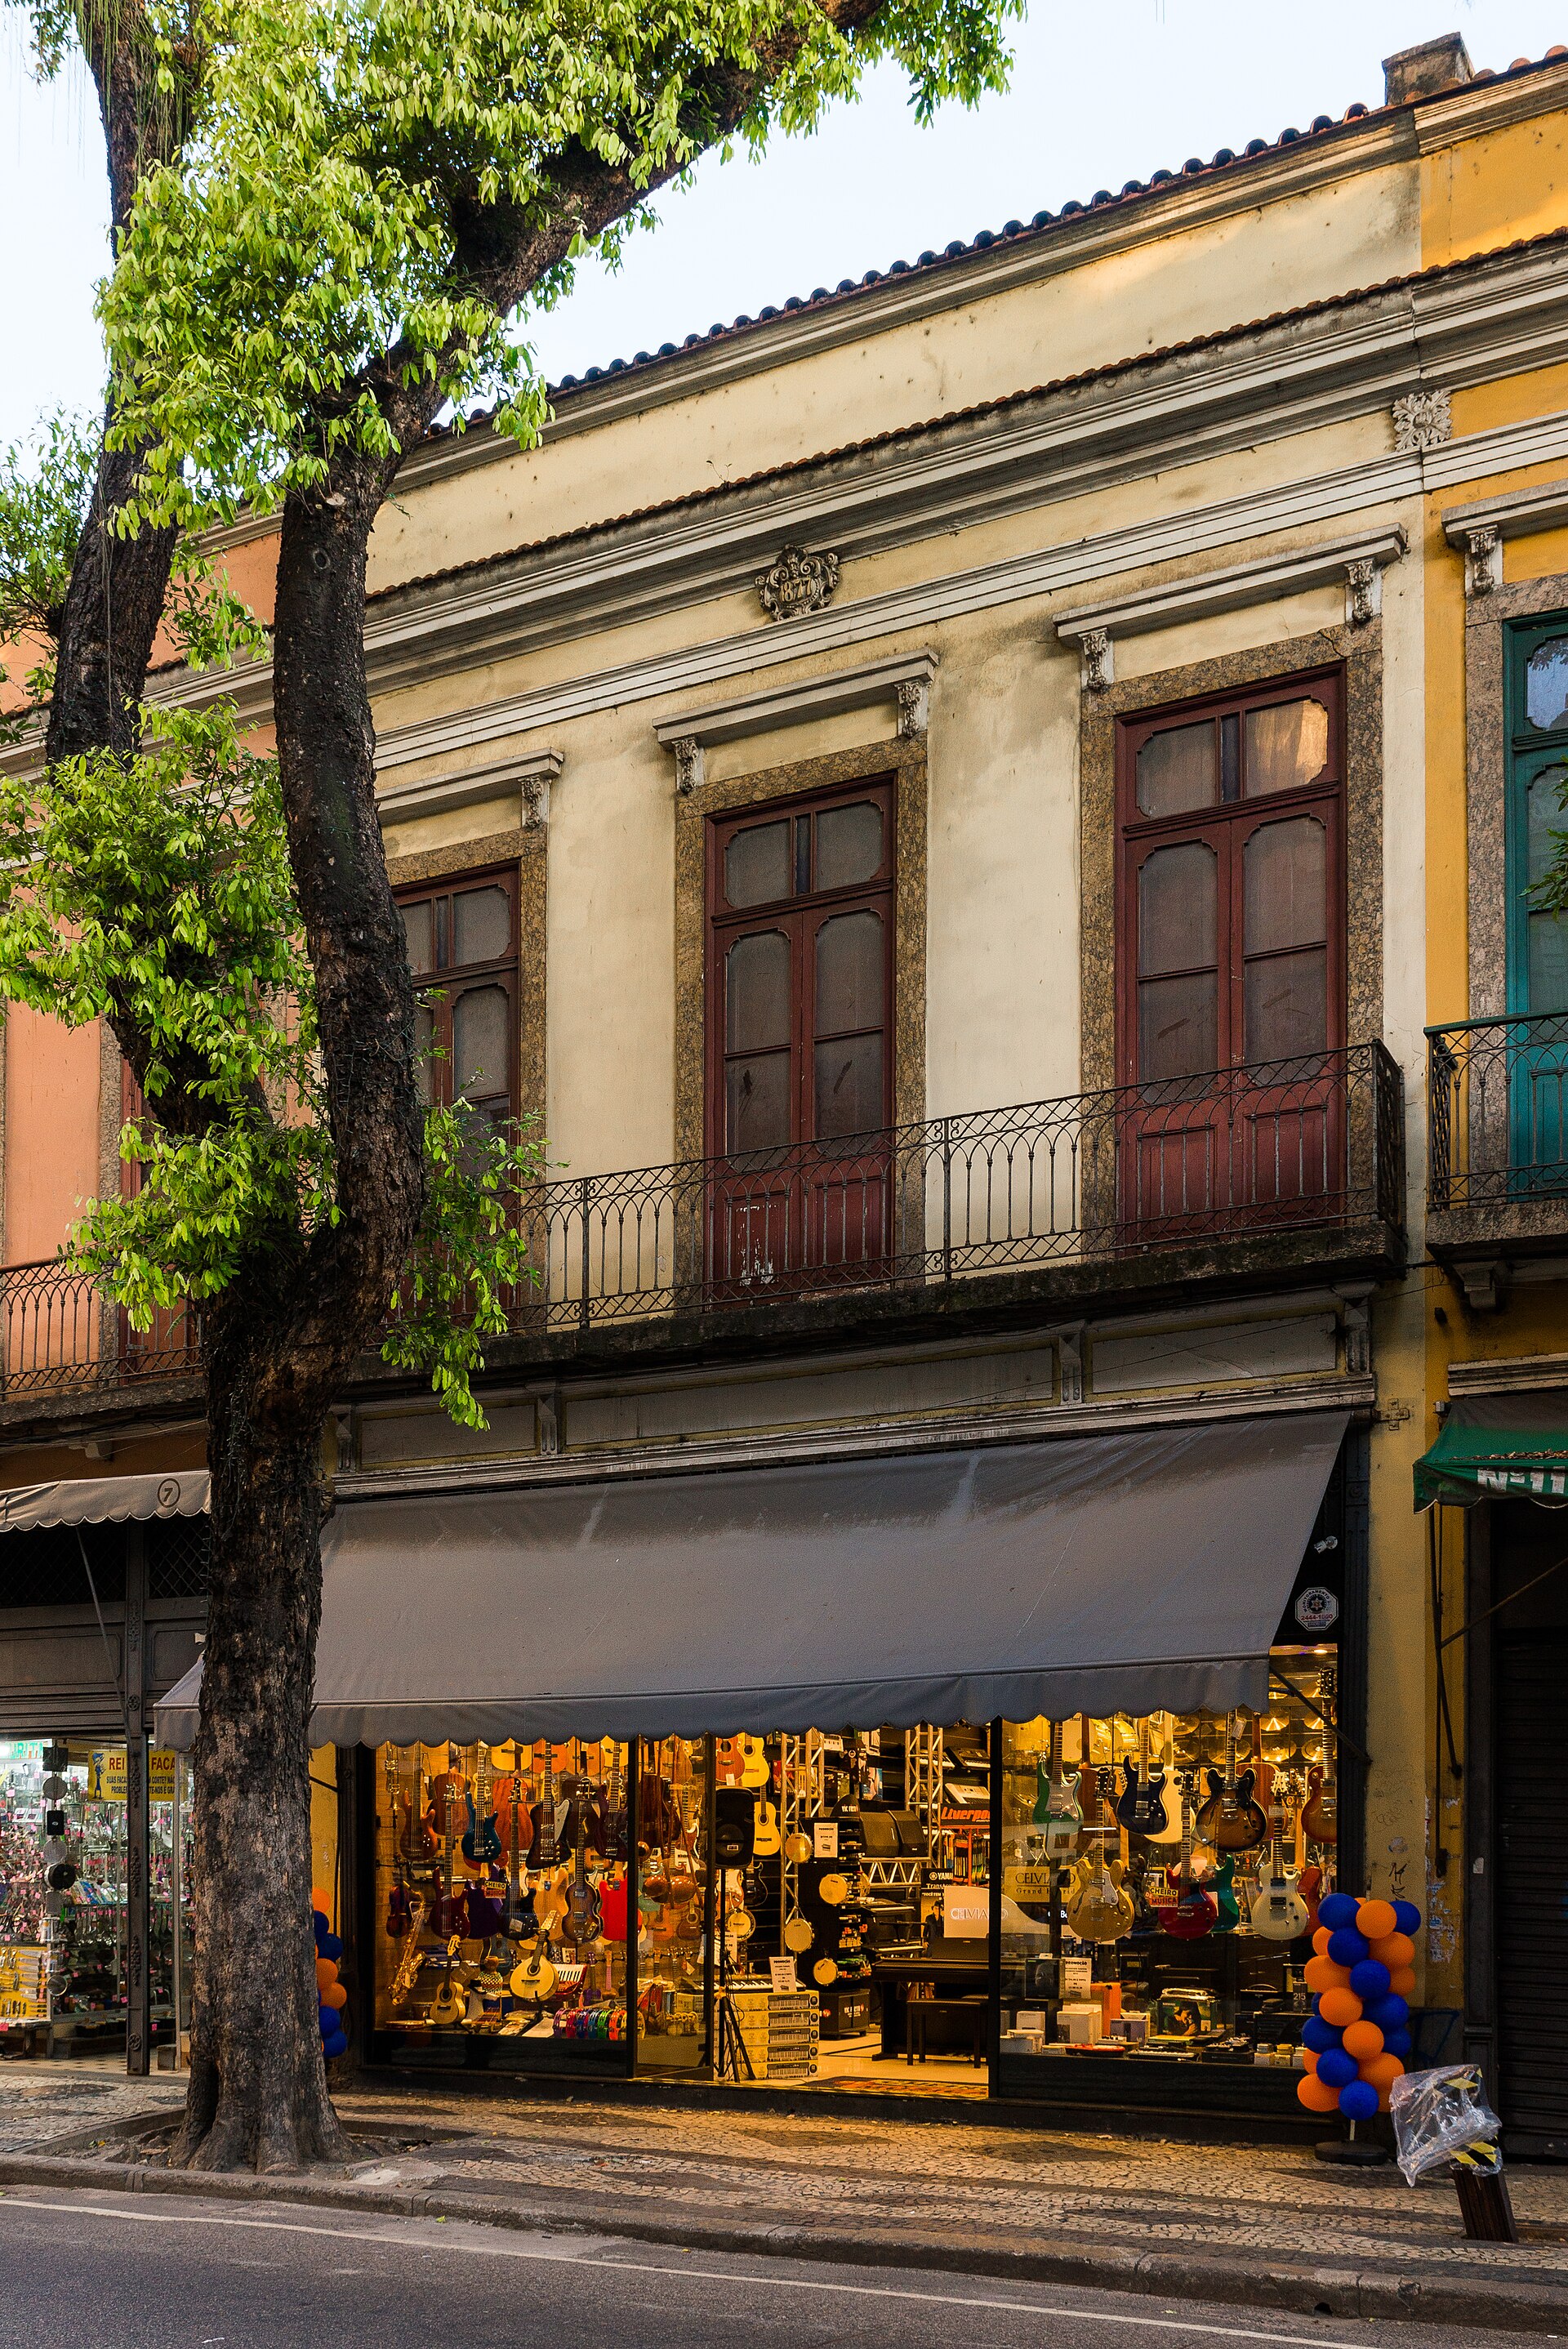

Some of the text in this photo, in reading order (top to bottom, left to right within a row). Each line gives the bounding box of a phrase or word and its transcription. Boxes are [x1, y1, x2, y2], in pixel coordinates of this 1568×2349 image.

[779, 577, 811, 603] 1877
[163, 1487, 173, 1503] 7
[109, 1757, 125, 1771] REI
[941, 1806, 991, 1822] Liverpo
[485, 1881, 506, 1889] CHEIRO
[1150, 1888, 1177, 1897] CHEIRO
[1293, 1992, 1307, 2000] 215
